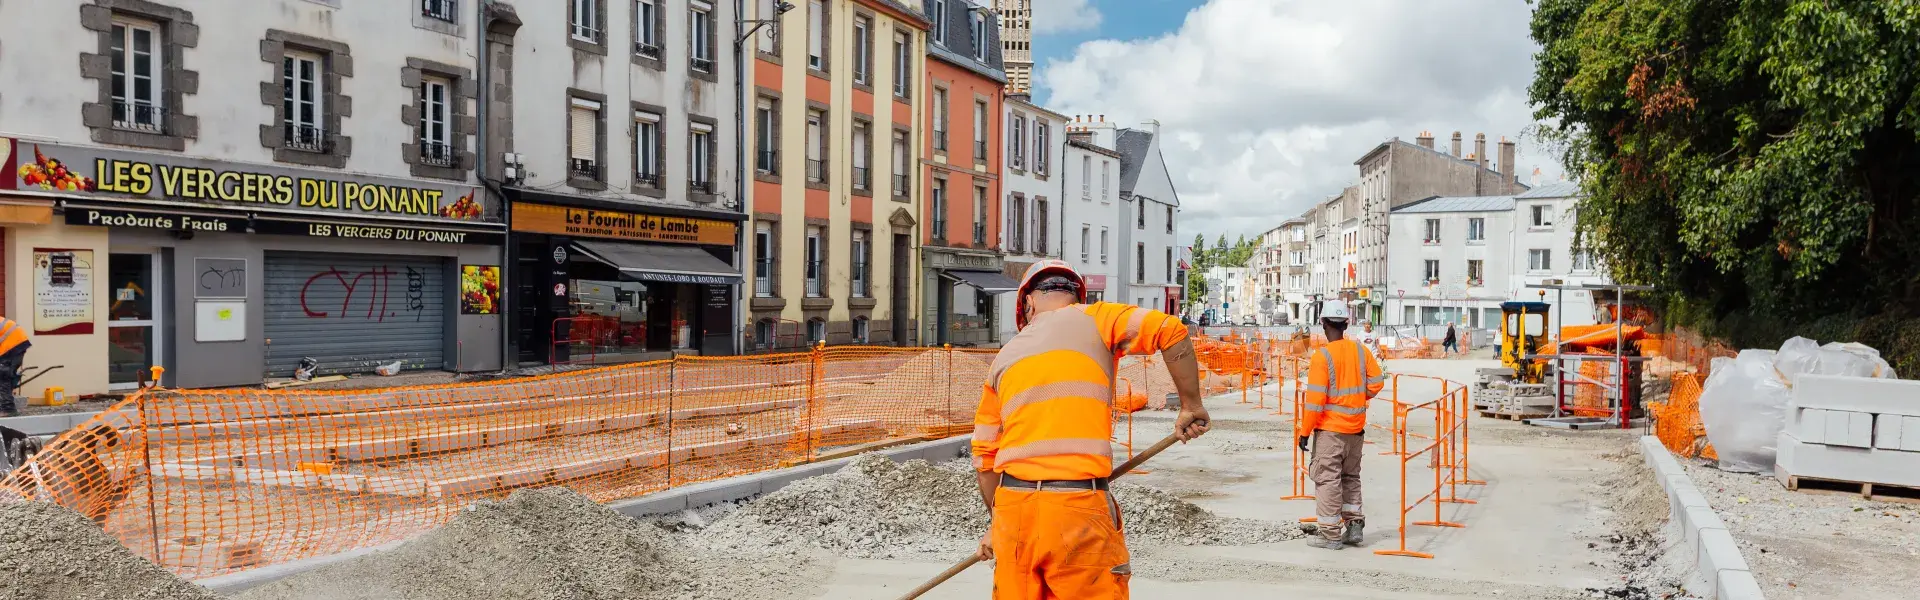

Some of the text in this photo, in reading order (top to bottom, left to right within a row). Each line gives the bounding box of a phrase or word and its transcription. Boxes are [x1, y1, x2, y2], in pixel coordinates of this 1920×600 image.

[96, 158, 443, 216] LES VERGERS DU PONANT
[88, 210, 227, 231] Produits Frais
[566, 208, 698, 233] Le Fournil de Lambé
[309, 224, 466, 243] LES VERGERS DU PONANT
[582, 227, 613, 236] TRADITION
